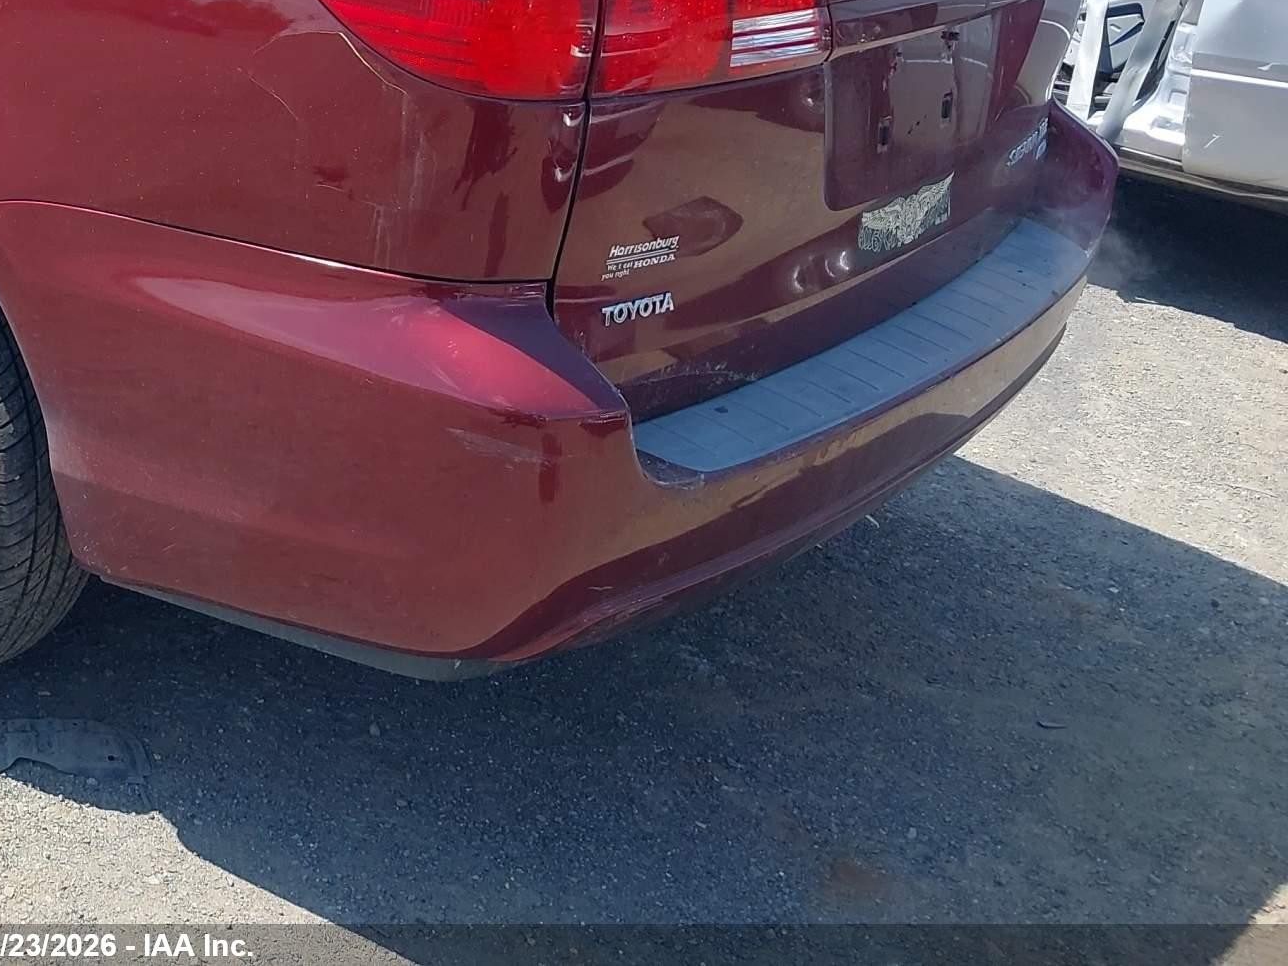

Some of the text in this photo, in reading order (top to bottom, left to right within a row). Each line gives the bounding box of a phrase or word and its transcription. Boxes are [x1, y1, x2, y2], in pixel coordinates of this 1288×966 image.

[608, 235, 680, 257] Harrisonburg
[633, 253, 676, 269] HONDA
[601, 292, 674, 327] TOYOTA
